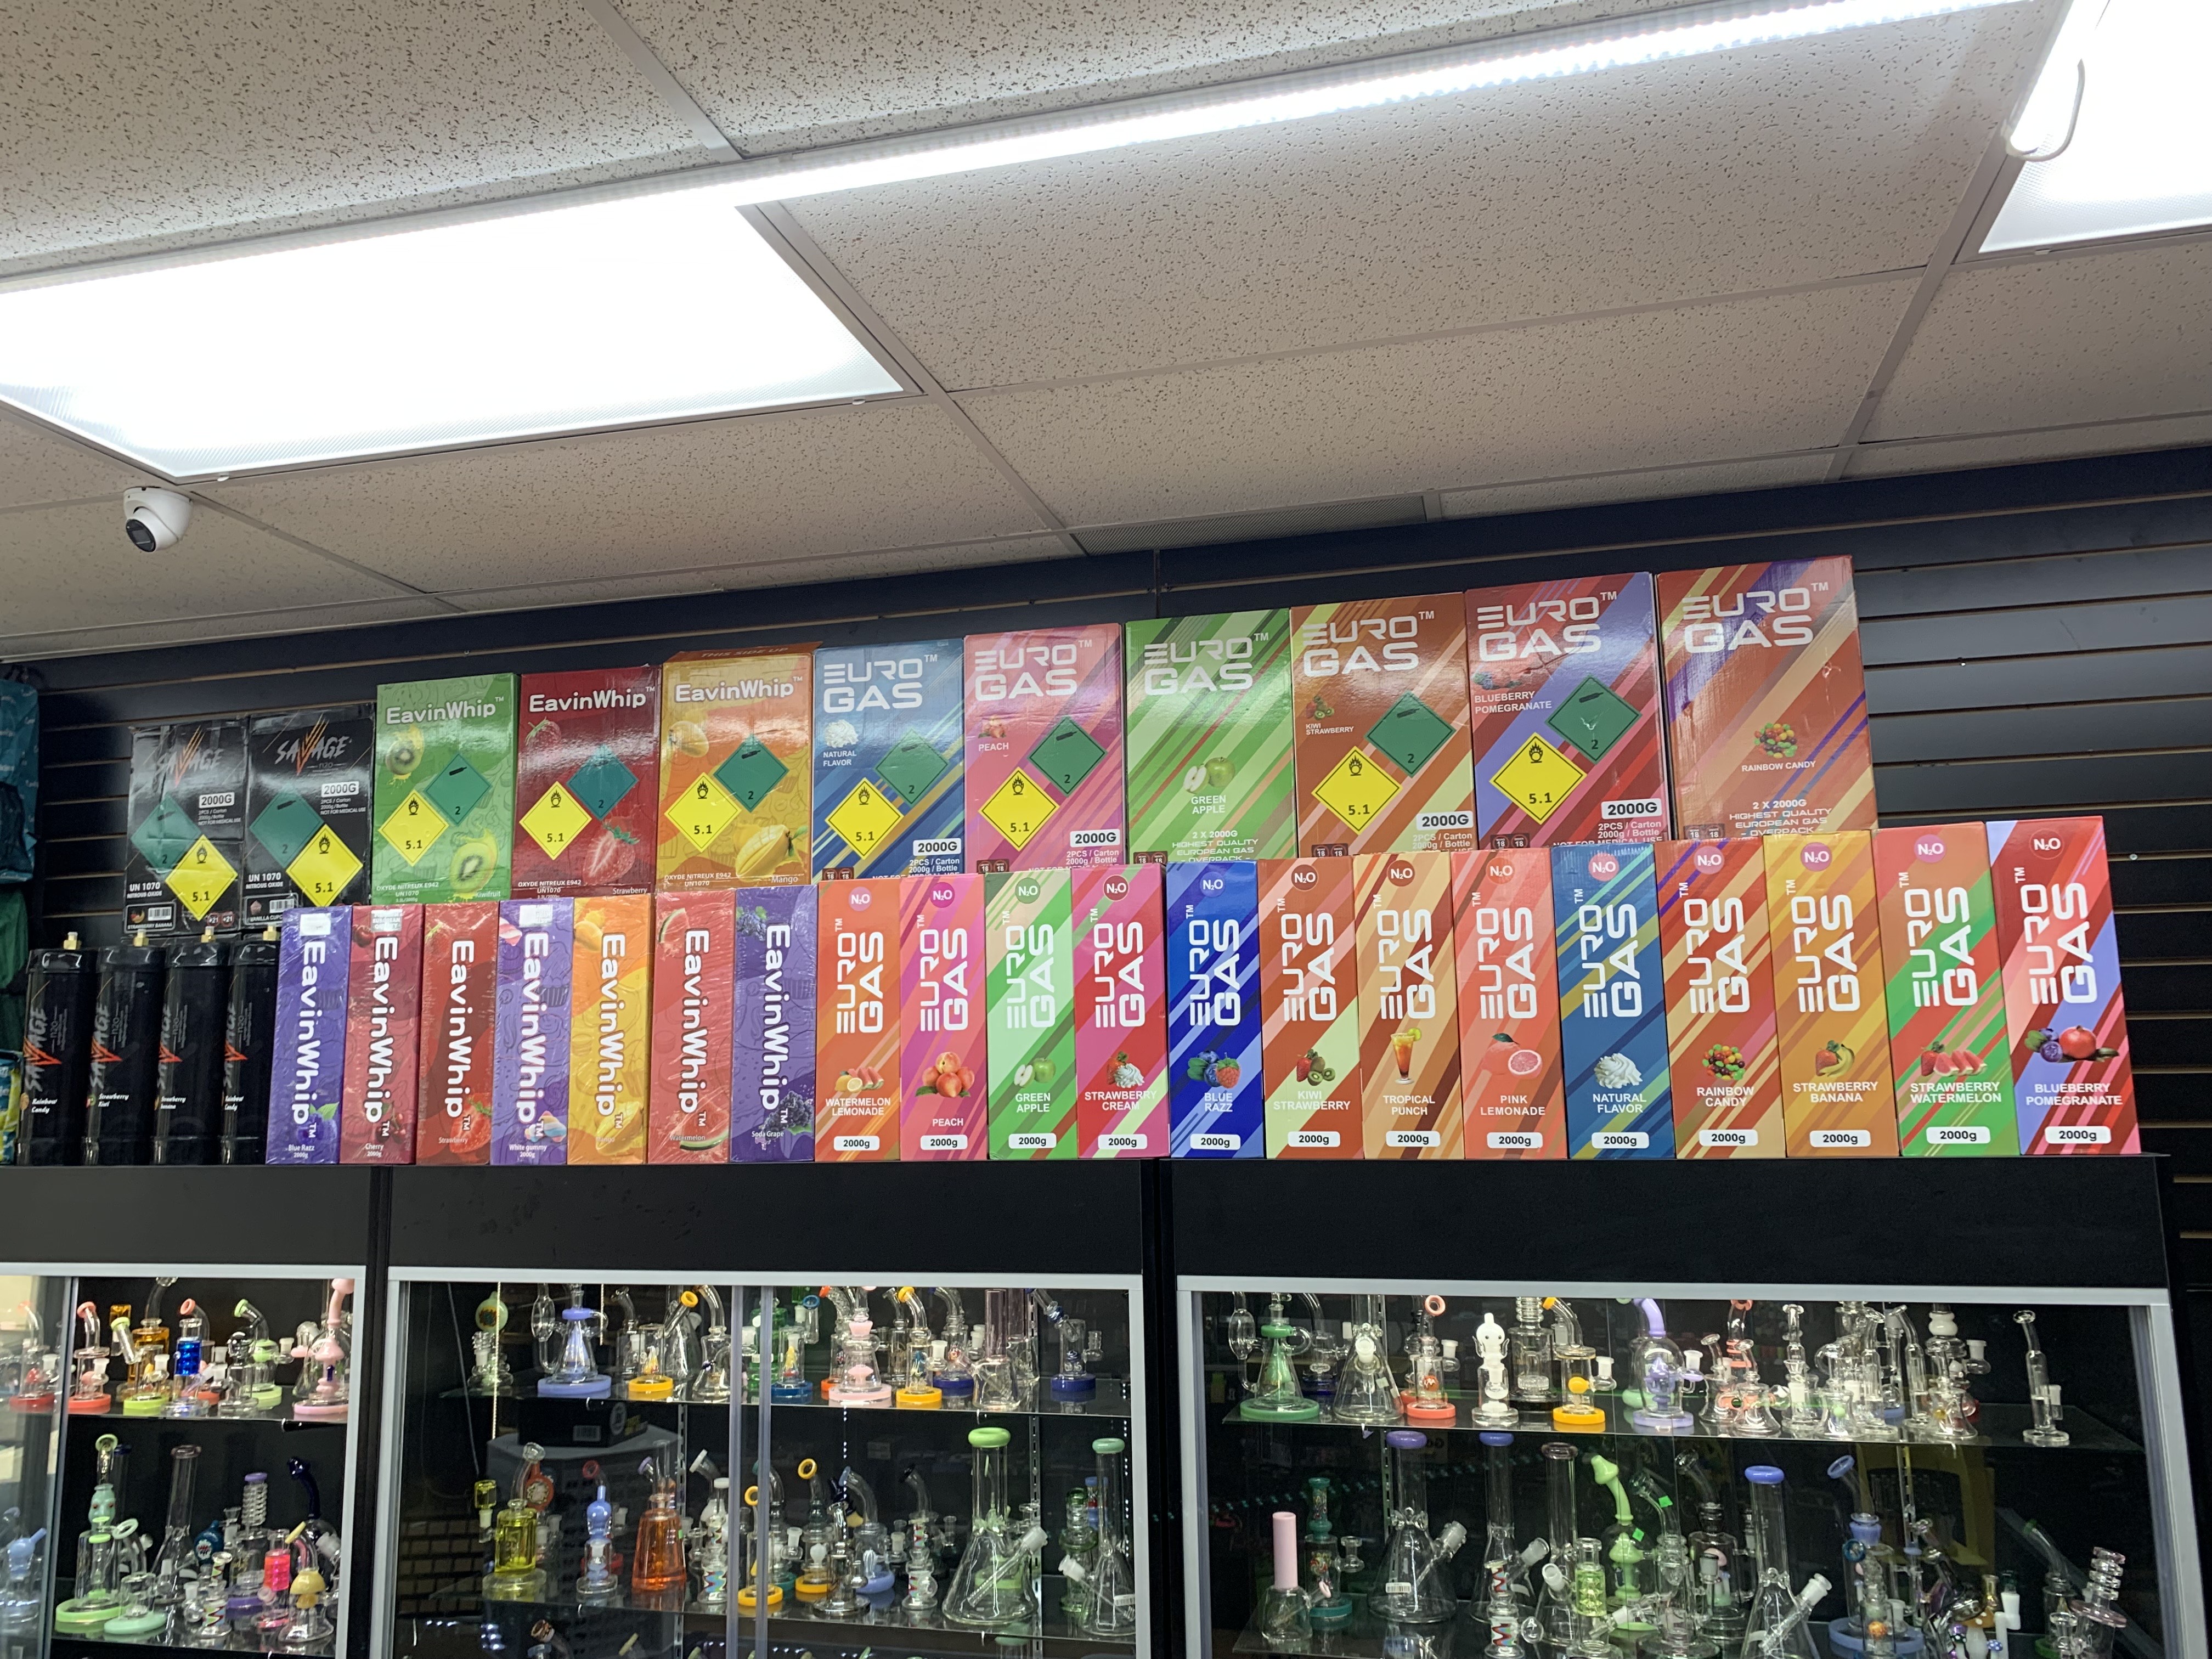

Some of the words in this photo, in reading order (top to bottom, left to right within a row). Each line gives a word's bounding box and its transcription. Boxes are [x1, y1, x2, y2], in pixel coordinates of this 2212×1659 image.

[1682, 588, 1810, 620] EURO
[1477, 596, 1599, 629] EURO
[1303, 616, 1418, 645] EURO
[1684, 615, 1814, 653] GAS
[1479, 623, 1602, 662] GAS
[1144, 637, 1252, 665] EURO
[975, 644, 1077, 671] EURO
[1304, 642, 1419, 678] GAS
[824, 658, 922, 684] EURO
[975, 669, 1077, 701] GAS
[1144, 663, 1252, 696] GAS
[675, 679, 794, 702] EavinWhip
[529, 689, 646, 712] EavinWhip
[824, 682, 922, 713] GAS
[1475, 691, 1534, 703] BLUEBERRY
[386, 699, 495, 724] EavinWhip
[1475, 701, 1552, 713] POMEGRANATE
[1306, 726, 1354, 735] STRAWBERRY
[979, 742, 1009, 751] PEACH
[1742, 763, 1784, 772] RAINBOW
[1786, 760, 1816, 770] CANDY
[324, 783, 356, 794] 2000G
[202, 794, 232, 805] 2000G
[1191, 795, 1226, 804] GREEN
[1528, 792, 1553, 804] 5.1
[1773, 799, 1807, 808] 2000G
[1192, 805, 1225, 814] APPLE
[1348, 804, 1370, 815] 5.1
[1608, 802, 1657, 815] 2000G
[1729, 811, 1778, 820] HIGHEST
[1783, 808, 1832, 817] QUALITY
[1422, 814, 1469, 827] 2000G
[1736, 820, 1798, 828] EUROPEAN
[694, 825, 712, 834] 5.1
[1598, 831, 1624, 839] 2000g
[1075, 832, 1116, 844] 2000G
[918, 842, 957, 853] 2000G
[262, 872, 281, 881] 1070
[771, 876, 798, 884] Mango
[143, 882, 160, 890] 1070
[315, 882, 333, 893] 5.1
[1904, 889, 1940, 1007] EURO
[1934, 887, 1978, 1006] GAS
[2020, 884, 2058, 1005] EURO
[2051, 883, 2098, 1003] GAS
[1791, 896, 1824, 1012] EURO
[1820, 895, 1860, 1012] GAS
[1377, 910, 1403, 1020] EURO
[1403, 909, 1436, 1019] GAS
[1476, 908, 1504, 1019] EURO
[1503, 907, 1537, 1019] GAS
[1579, 905, 1609, 1018] EURO
[1606, 904, 1642, 1017] GAS
[1006, 926, 1026, 1029] EURO
[1028, 924, 1055, 1028] GAS
[1094, 923, 1115, 1028] EURO
[1117, 922, 1145, 1027] GAS
[1189, 920, 1210, 1026] EURO
[1213, 919, 1240, 1026] GAS
[837, 932, 856, 1034] EURO
[859, 932, 883, 1033] GAS
[678, 930, 709, 1113] EavinWhip
[761, 924, 791, 1110] EavinWhip
[365, 936, 398, 1123] EavinWhip
[445, 940, 475, 1118] EavinWhip
[517, 933, 548, 1122] EavinWhip
[596, 934, 625, 1115] EavinWhip
[292, 941, 326, 1125] EavinWhip
[1696, 1087, 1754, 1096] RAINBOW
[1793, 1081, 1878, 1092] STRAWBERRY
[1910, 1082, 2000, 1093] STRAWBERRY
[2035, 1083, 2109, 1093] BLUEBERRY
[1015, 1093, 1051, 1102] GREEN
[1085, 1091, 1156, 1101] STRAWBERRY
[1204, 1092, 1233, 1102] BLUE
[1297, 1091, 1322, 1100] KIWI
[1383, 1094, 1435, 1104] TROPICAL
[1500, 1095, 1527, 1104] PINK
[1593, 1093, 1646, 1102] NATURAL
[1810, 1092, 1864, 1103] BANANA
[1910, 1093, 2001, 1103] WATERMELON
[2026, 1094, 2122, 1106] POMEGRANATE
[826, 1098, 891, 1107] WATERMELON
[1017, 1103, 1050, 1113] APPLE
[1102, 1101, 1139, 1110] CREAM
[1205, 1103, 1233, 1112] RAZZ
[1273, 1101, 1351, 1110] STRAWBERRY
[1705, 1097, 1747, 1107] CANDY
[832, 1107, 884, 1116] LEMONADE
[1392, 1106, 1428, 1115] PUNCH
[1481, 1107, 1545, 1116] LEMONADE
[1598, 1104, 1643, 1113] FLAVOR
[933, 1118, 963, 1126] PEACH
[766, 1130, 784, 1138] Grape
[1397, 1135, 1429, 1144] 2000g
[1822, 1133, 1858, 1144] 2000g
[1939, 1131, 1977, 1141] 2000g
[2059, 1130, 2097, 1141] 2000g
[843, 1139, 870, 1148] 2000g
[1019, 1137, 1046, 1146] 2000g
[1201, 1137, 1230, 1147] 2000g
[1604, 1136, 1637, 1146] 2000g
